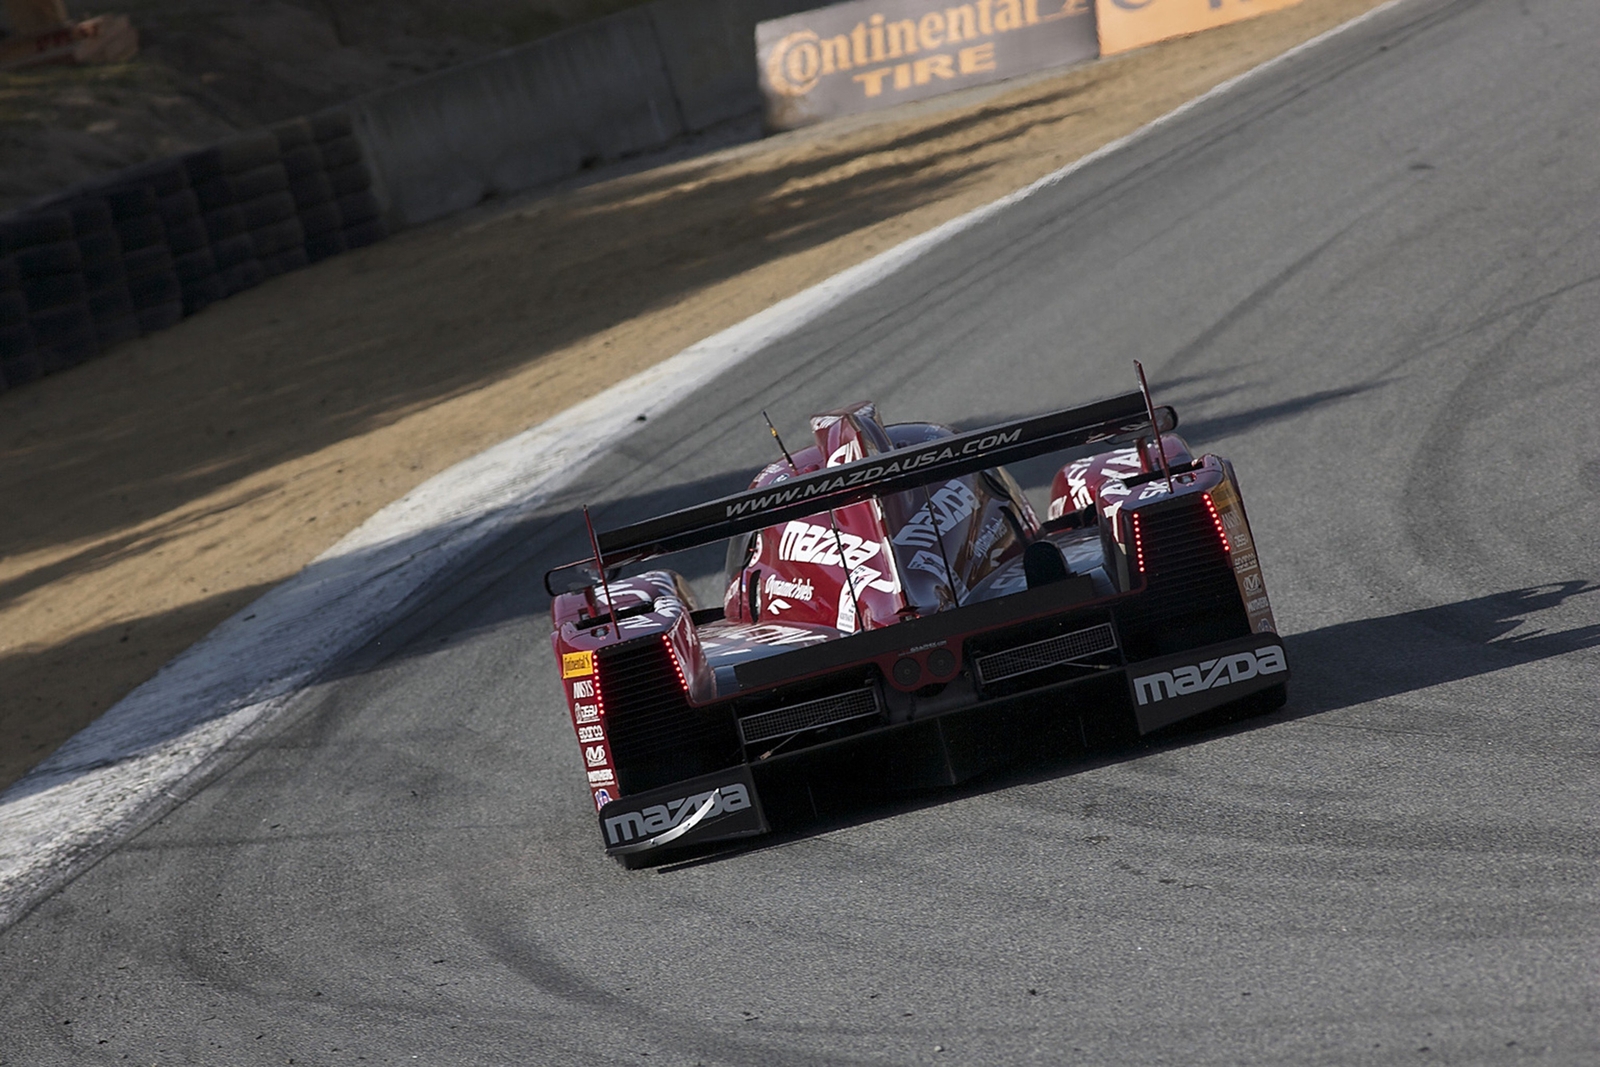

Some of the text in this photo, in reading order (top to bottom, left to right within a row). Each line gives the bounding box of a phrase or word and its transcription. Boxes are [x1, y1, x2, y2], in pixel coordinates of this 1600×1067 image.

[766, 0, 1040, 96] Continental
[853, 42, 997, 98] TIRE
[726, 428, 1023, 517] WWW.MAZDAUSA.COM
